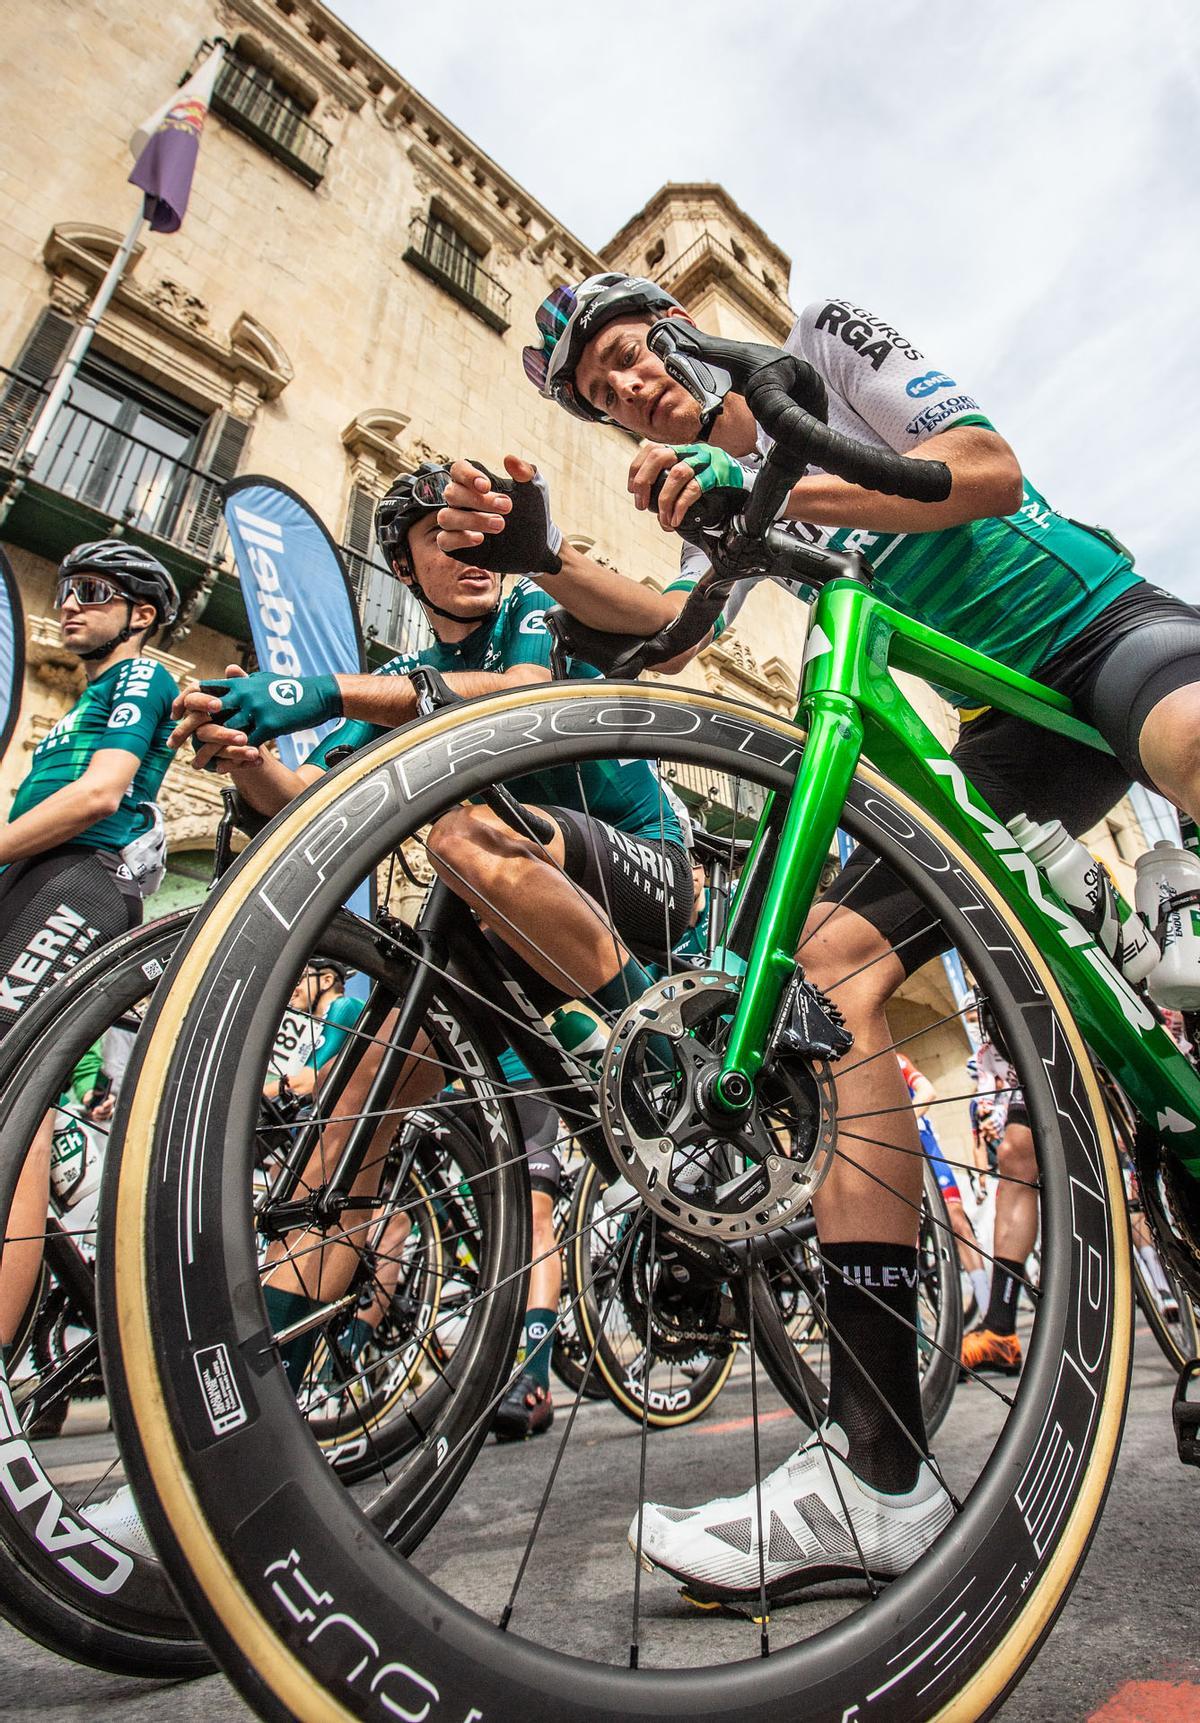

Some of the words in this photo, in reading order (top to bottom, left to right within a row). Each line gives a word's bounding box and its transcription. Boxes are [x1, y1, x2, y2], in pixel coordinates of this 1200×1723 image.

[815, 303, 893, 371] RGA
[910, 373, 953, 395] KMC
[123, 657, 157, 698] ERN
[605, 823, 674, 889] KERN
[613, 850, 676, 910] PHARMA
[0, 904, 86, 1011] KERN
[272, 1018, 306, 1062] 182
